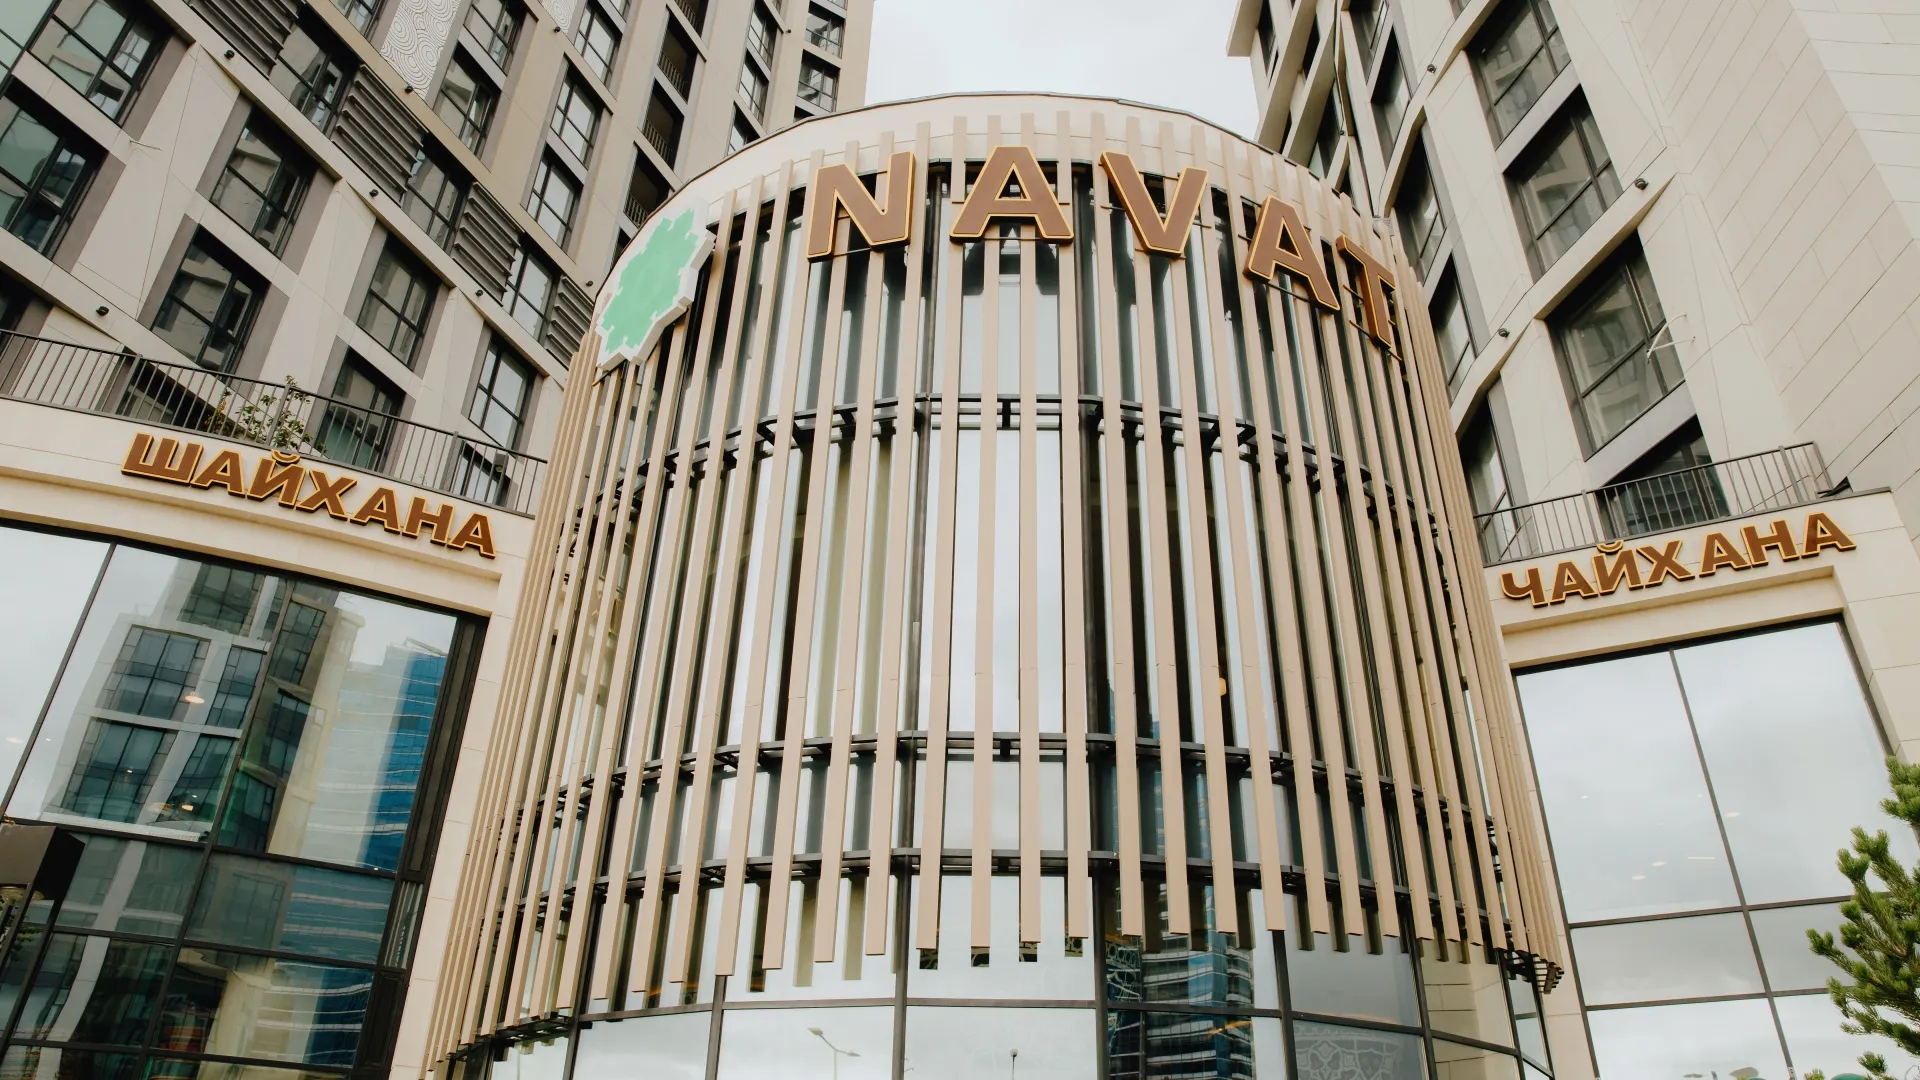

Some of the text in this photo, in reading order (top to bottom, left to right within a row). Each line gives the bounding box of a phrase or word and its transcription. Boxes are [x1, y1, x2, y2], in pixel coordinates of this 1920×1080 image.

[806, 145, 1396, 349] NAVAT
[121, 432, 496, 559] ШАЙХАНА
[1500, 511, 1857, 608] ЧАЙХАНА
